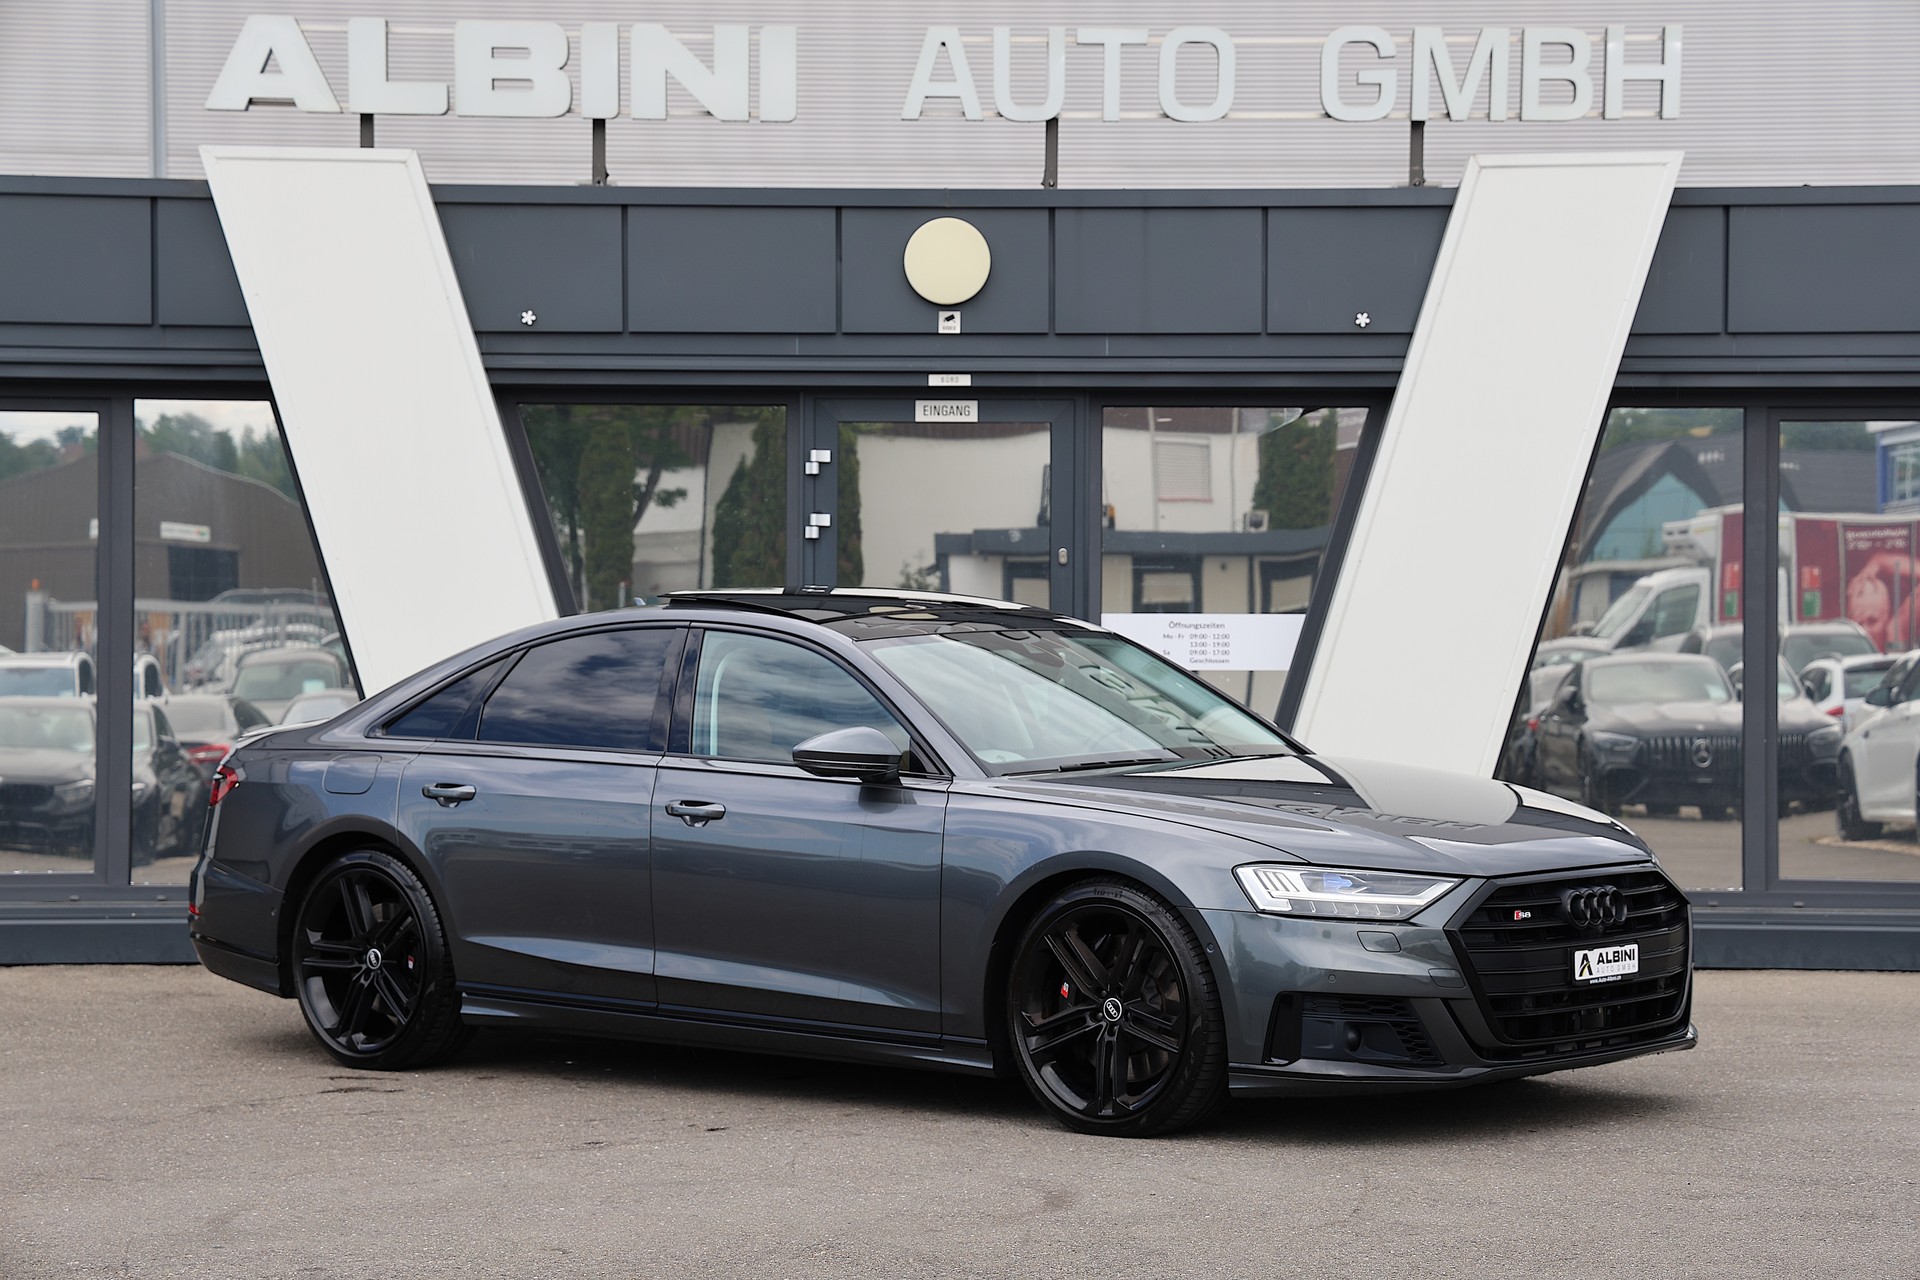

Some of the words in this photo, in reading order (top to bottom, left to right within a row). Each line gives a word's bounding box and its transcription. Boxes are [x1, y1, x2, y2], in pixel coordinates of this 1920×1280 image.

[205, 15, 797, 122] ALBINI
[901, 25, 1236, 123] AUTO
[1318, 24, 1683, 123] GMBH
[922, 404, 971, 417] EINGANG
[1168, 620, 1226, 630] Öffnungszeiten
[1596, 948, 1636, 965] ALBINI
